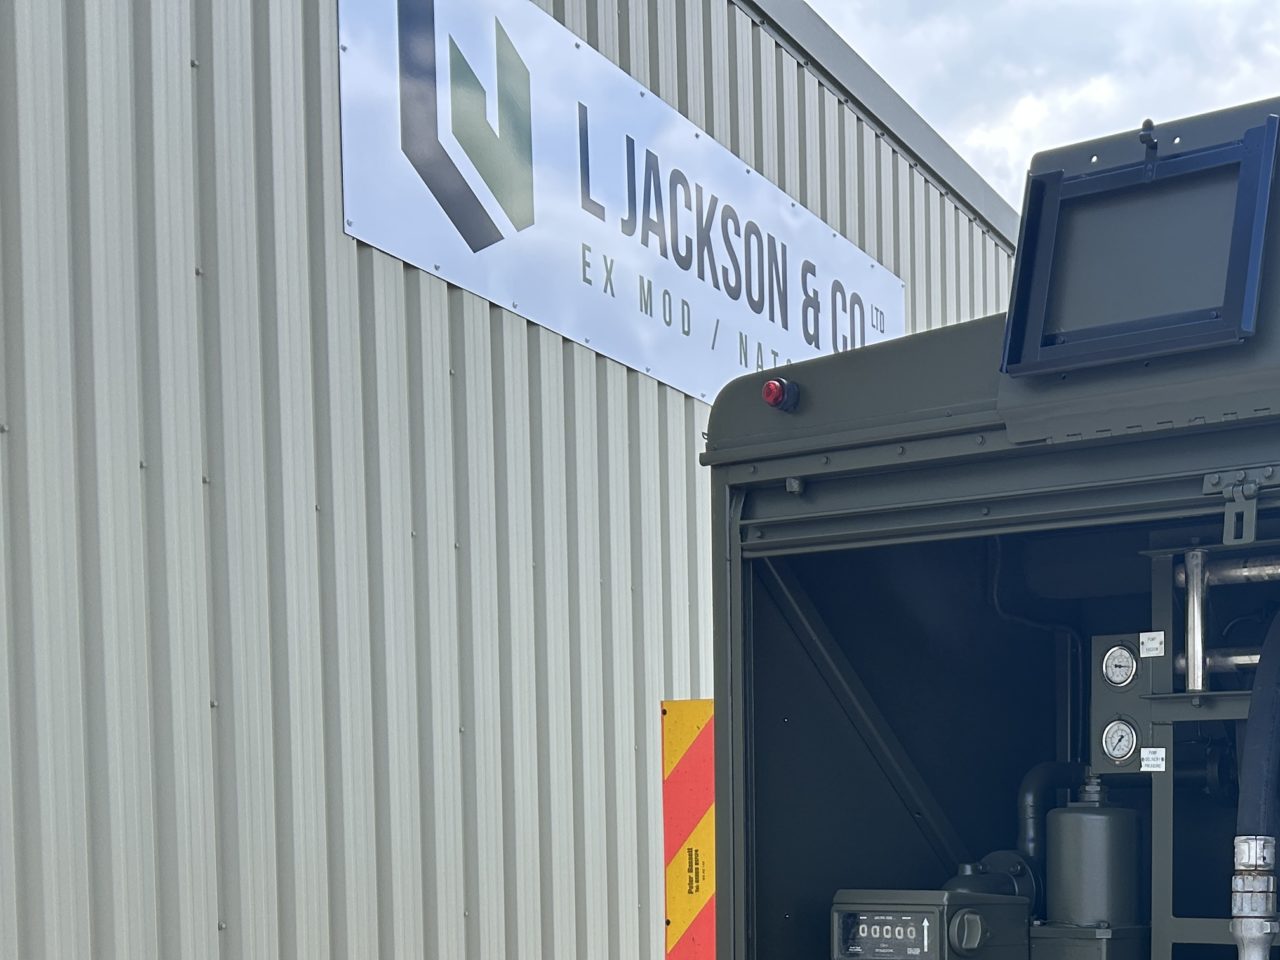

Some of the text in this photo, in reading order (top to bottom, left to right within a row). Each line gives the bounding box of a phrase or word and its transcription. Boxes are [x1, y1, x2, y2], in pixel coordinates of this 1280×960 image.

[577, 101, 606, 222] L
[620, 133, 789, 331] JACKSON
[801, 259, 821, 350] &
[870, 303, 885, 334] LTD
[581, 242, 616, 299] EX
[639, 274, 692, 337] MOD
[738, 331, 792, 373] NAT
